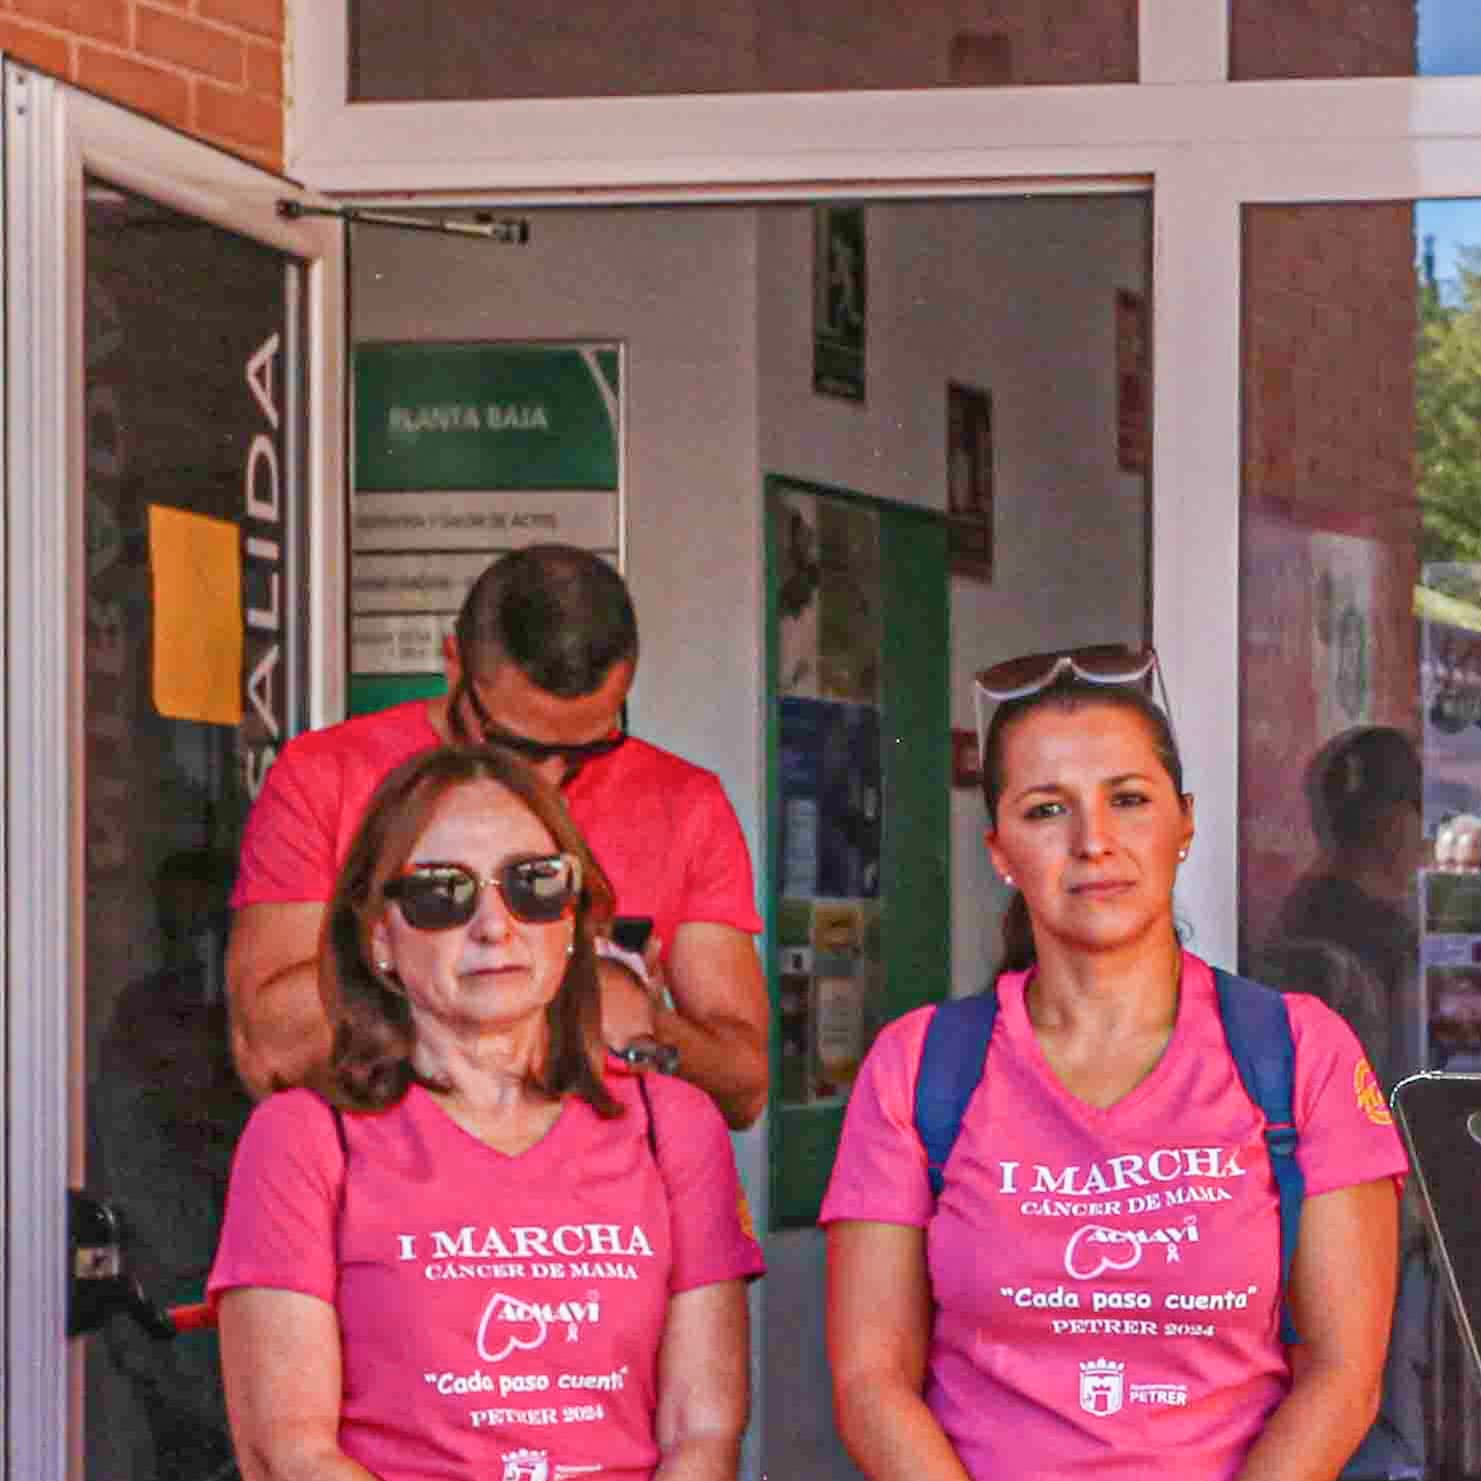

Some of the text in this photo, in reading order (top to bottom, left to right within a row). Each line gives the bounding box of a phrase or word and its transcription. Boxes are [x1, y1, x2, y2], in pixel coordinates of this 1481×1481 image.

[999, 1147, 1246, 1196] I MARCHA
[1020, 1186, 1232, 1217] CÁNCER DE MAMA
[397, 1223, 654, 1260] I MARCHA
[424, 1262, 638, 1281] CÁNCER DE MAMA
[1092, 1292, 1152, 1312] paso
[1051, 1318, 1216, 1337] PETRER 2024
[499, 1374, 549, 1397] paso
[1130, 1391, 1188, 1406] PETRER
